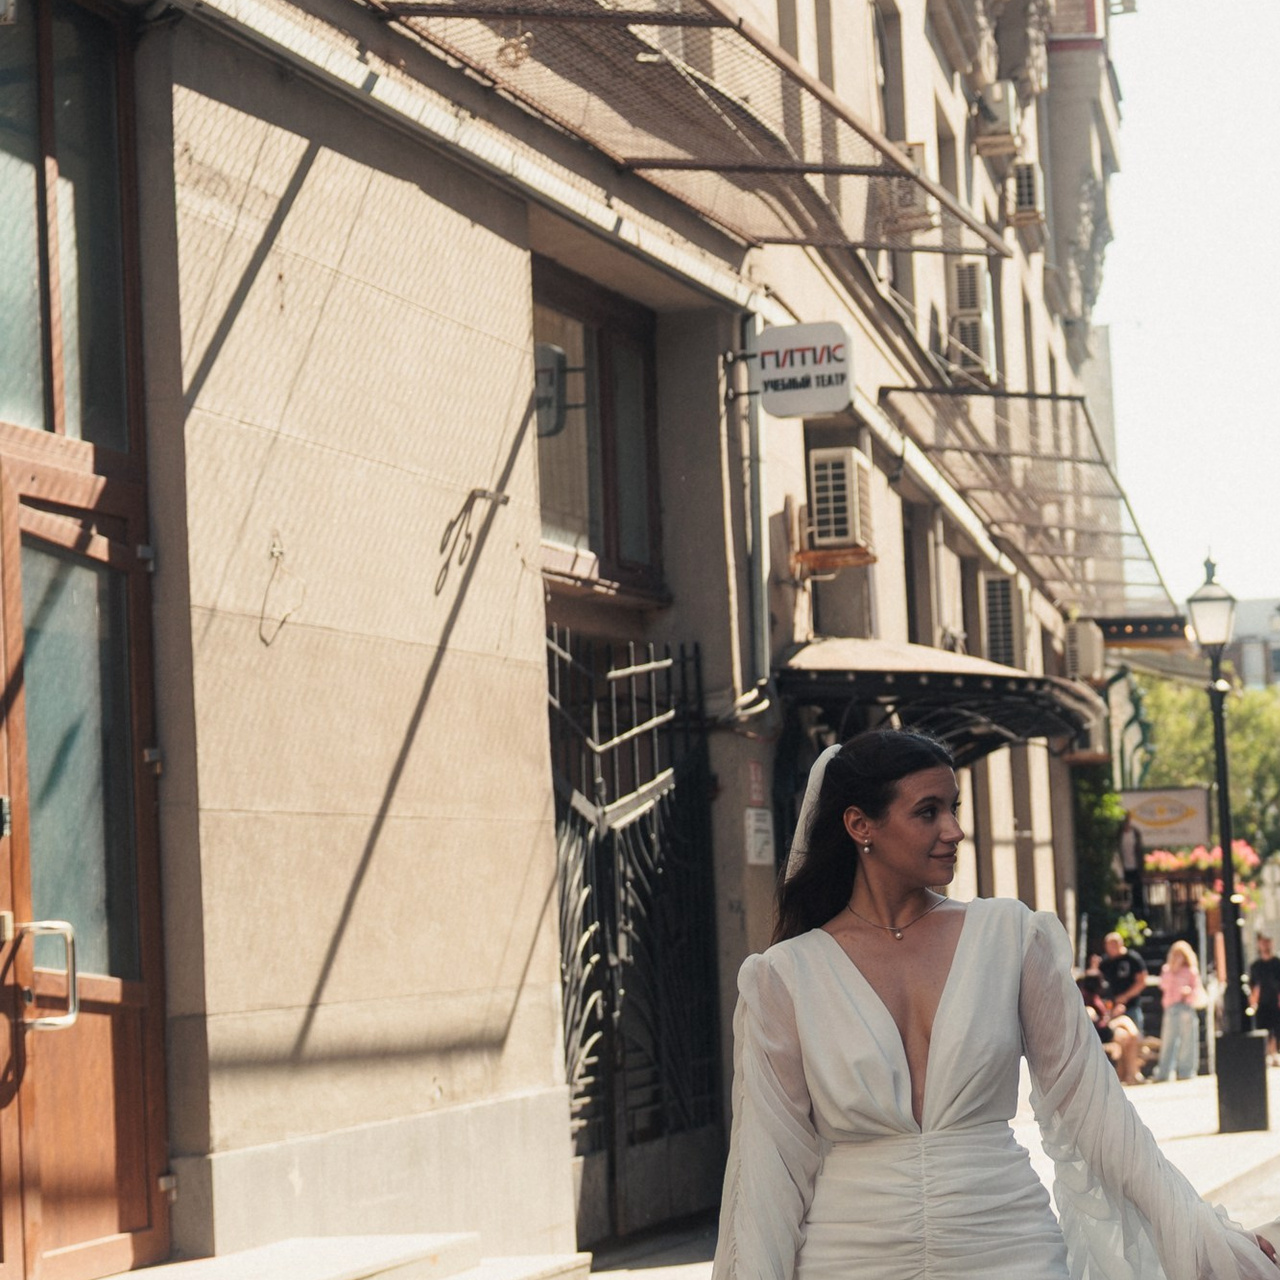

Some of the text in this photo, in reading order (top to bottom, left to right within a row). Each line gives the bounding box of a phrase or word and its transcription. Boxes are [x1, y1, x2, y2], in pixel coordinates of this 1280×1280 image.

[761, 343, 845, 370] ГИТИС
[763, 372, 847, 393] УЧЕБНЫЙ ТЕАТР
